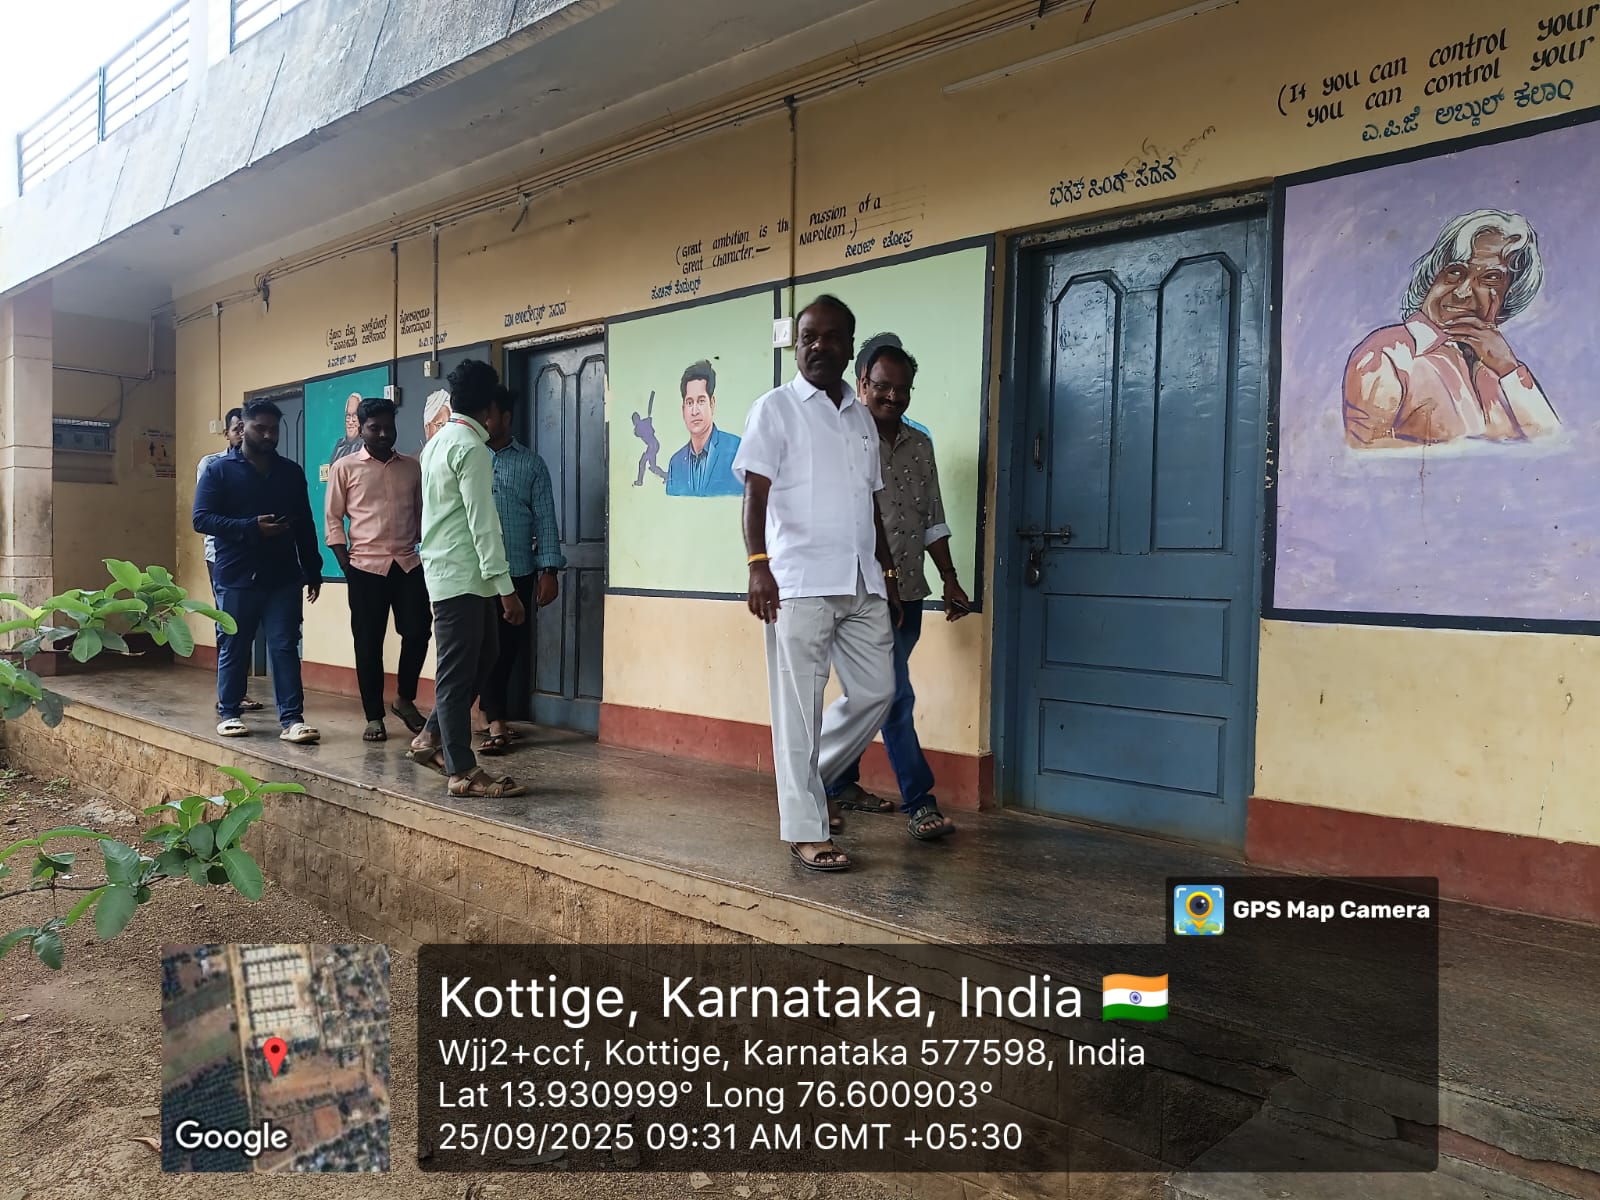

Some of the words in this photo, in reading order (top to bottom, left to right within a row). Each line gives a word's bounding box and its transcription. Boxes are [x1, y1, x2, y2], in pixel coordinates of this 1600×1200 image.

[1322, 69, 1361, 97] you
[1368, 55, 1408, 84] can
[1428, 28, 1509, 69] control
[1536, 3, 1600, 42] your
[1306, 100, 1345, 128] you
[1364, 86, 1403, 111] can
[1423, 57, 1502, 97] control
[1529, 35, 1596, 72] your
[1513, 78, 1575, 109] ಕಲಾಂ
[1049, 176, 1085, 208] ಭಗತ್
[1087, 168, 1129, 199] ಸಿಂಗ್
[712, 229, 749, 251] ambition
[759, 223, 768, 239] is
[857, 192, 871, 214] of
[873, 197, 882, 210] a
